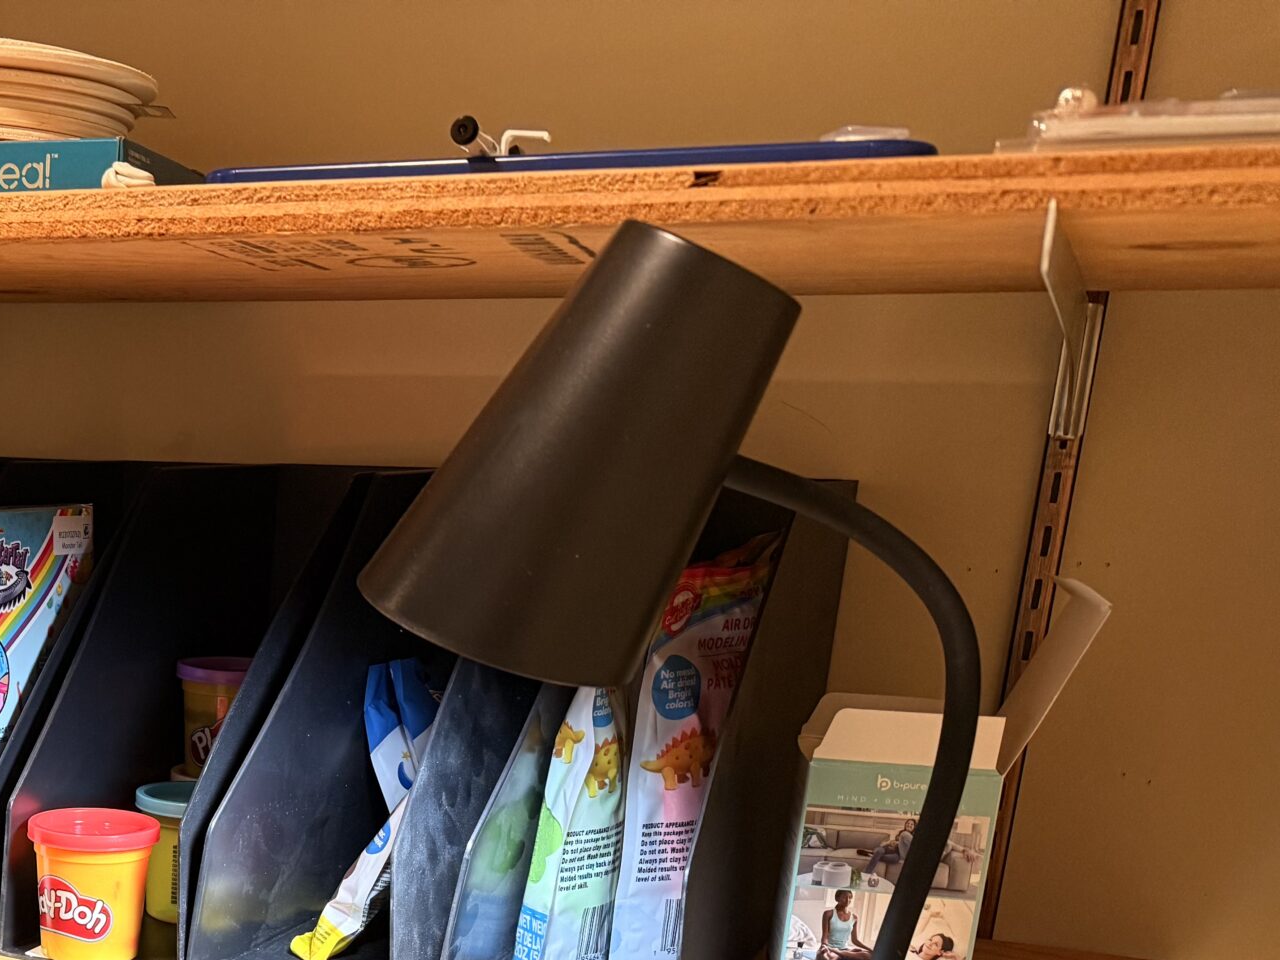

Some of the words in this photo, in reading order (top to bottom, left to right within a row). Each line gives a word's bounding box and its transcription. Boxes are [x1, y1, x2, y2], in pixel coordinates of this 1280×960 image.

[722, 617, 741, 632] AIR
[697, 634, 749, 651] MODELIN
[660, 670, 675, 679] No
[660, 679, 675, 690] Air
[642, 822, 664, 830] PRODUCT
[664, 820, 694, 829] APPEARANCE
[652, 829, 662, 837] this
[663, 829, 684, 837] package
[640, 839, 648, 847] Do
[648, 838, 657, 846] not
[658, 837, 675, 846] place
[675, 837, 687, 846] clay
[562, 848, 570, 856] Do
[579, 846, 592, 854] place
[640, 848, 647, 856] Do
[648, 848, 657, 856] not
[670, 846, 685, 854] Wash
[561, 857, 568, 865] Do
[568, 856, 577, 864] not
[586, 852, 598, 861] Wash
[638, 857, 658, 866] Always
[658, 856, 668, 865] put
[669, 855, 682, 864] clay
[560, 866, 576, 876] Always
[637, 866, 657, 874] Molded
[658, 864, 678, 873] results
[560, 875, 577, 883] Molded
[635, 875, 650, 883] level
[650, 874, 657, 882] of
[658, 873, 672, 881] skill.
[558, 884, 571, 892] level
